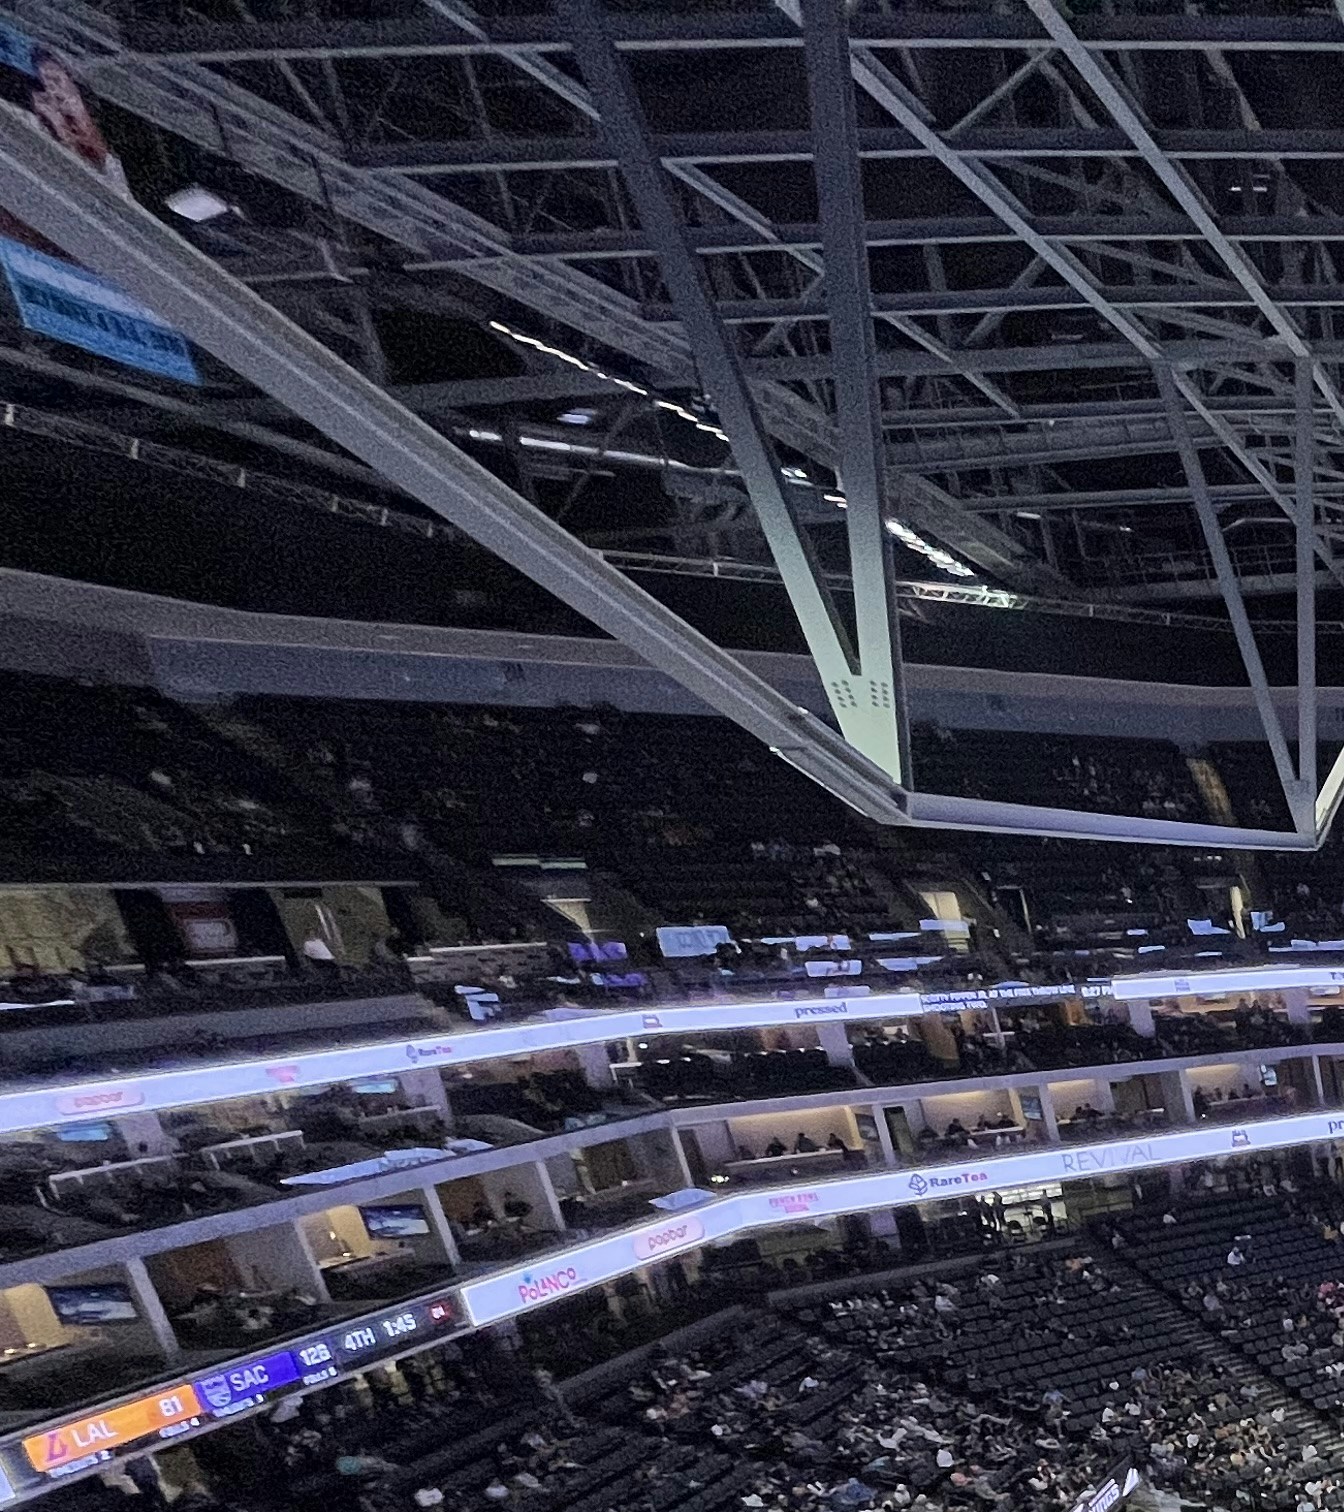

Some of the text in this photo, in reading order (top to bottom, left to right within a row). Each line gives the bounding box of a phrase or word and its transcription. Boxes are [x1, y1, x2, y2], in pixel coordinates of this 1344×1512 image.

[793, 1001, 848, 1019] pressed
[1061, 1144, 1162, 1174] REVIVAL
[929, 1171, 988, 1189] RareTea
[647, 1223, 689, 1250] popbar
[70, 1420, 118, 1448] LAL
[159, 1396, 184, 1417] 81
[229, 1364, 269, 1392] SAC
[344, 1327, 376, 1350] 4TH
[382, 1313, 417, 1337] 1:45
